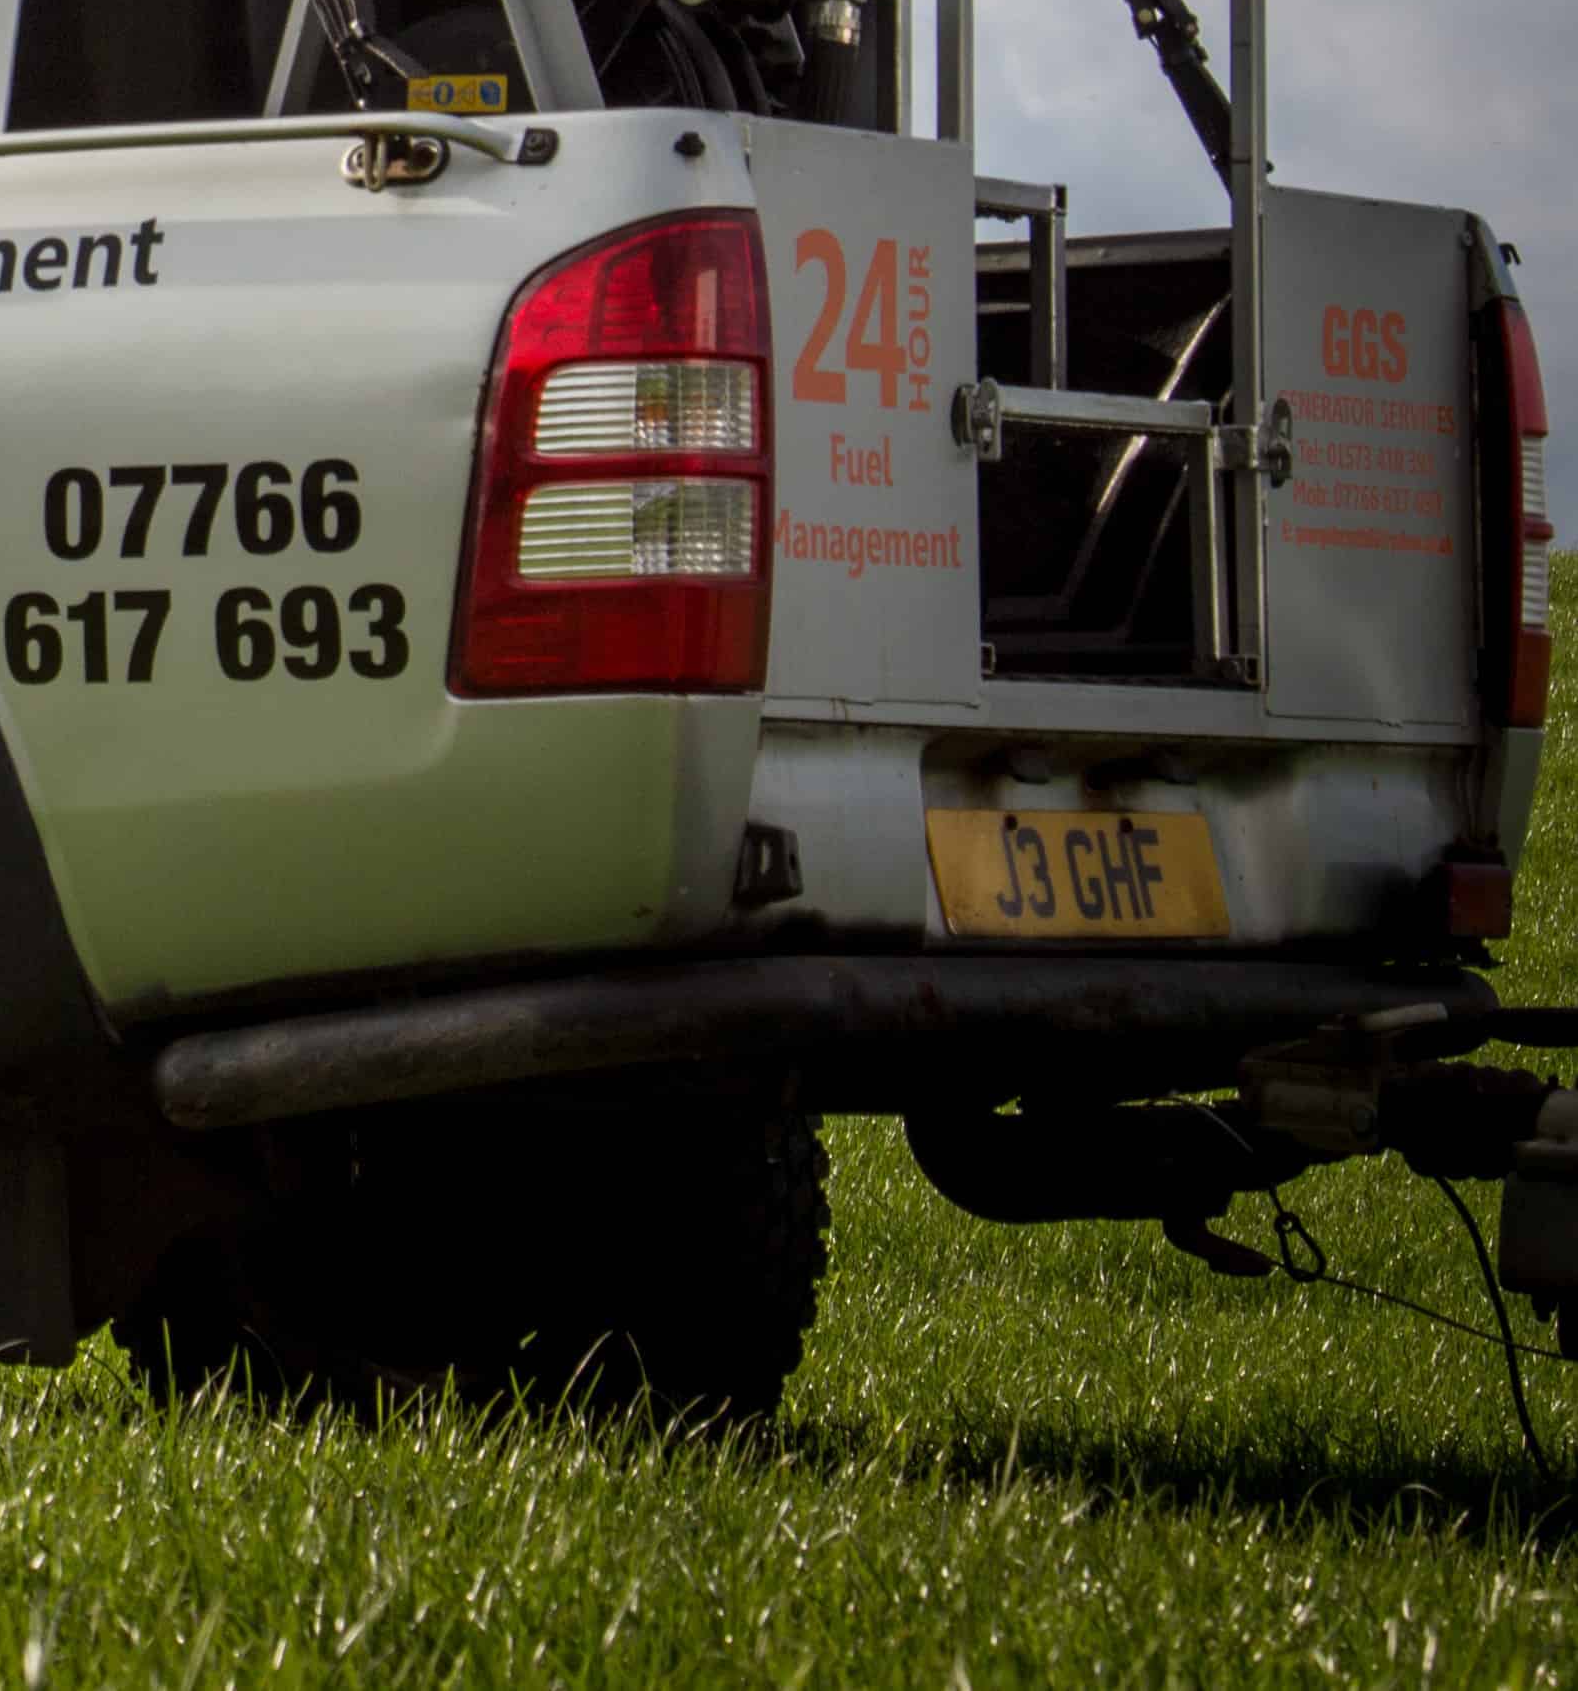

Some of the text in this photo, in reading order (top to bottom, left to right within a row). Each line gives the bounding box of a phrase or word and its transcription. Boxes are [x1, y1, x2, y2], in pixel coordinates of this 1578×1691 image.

[792, 227, 932, 413] 24 HOUR
[1321, 302, 1408, 386] GGS
[44, 457, 362, 561] 07766
[830, 431, 894, 487] Fuel
[4, 582, 410, 685] 617 693
[996, 817, 1163, 921] J3 GHF
